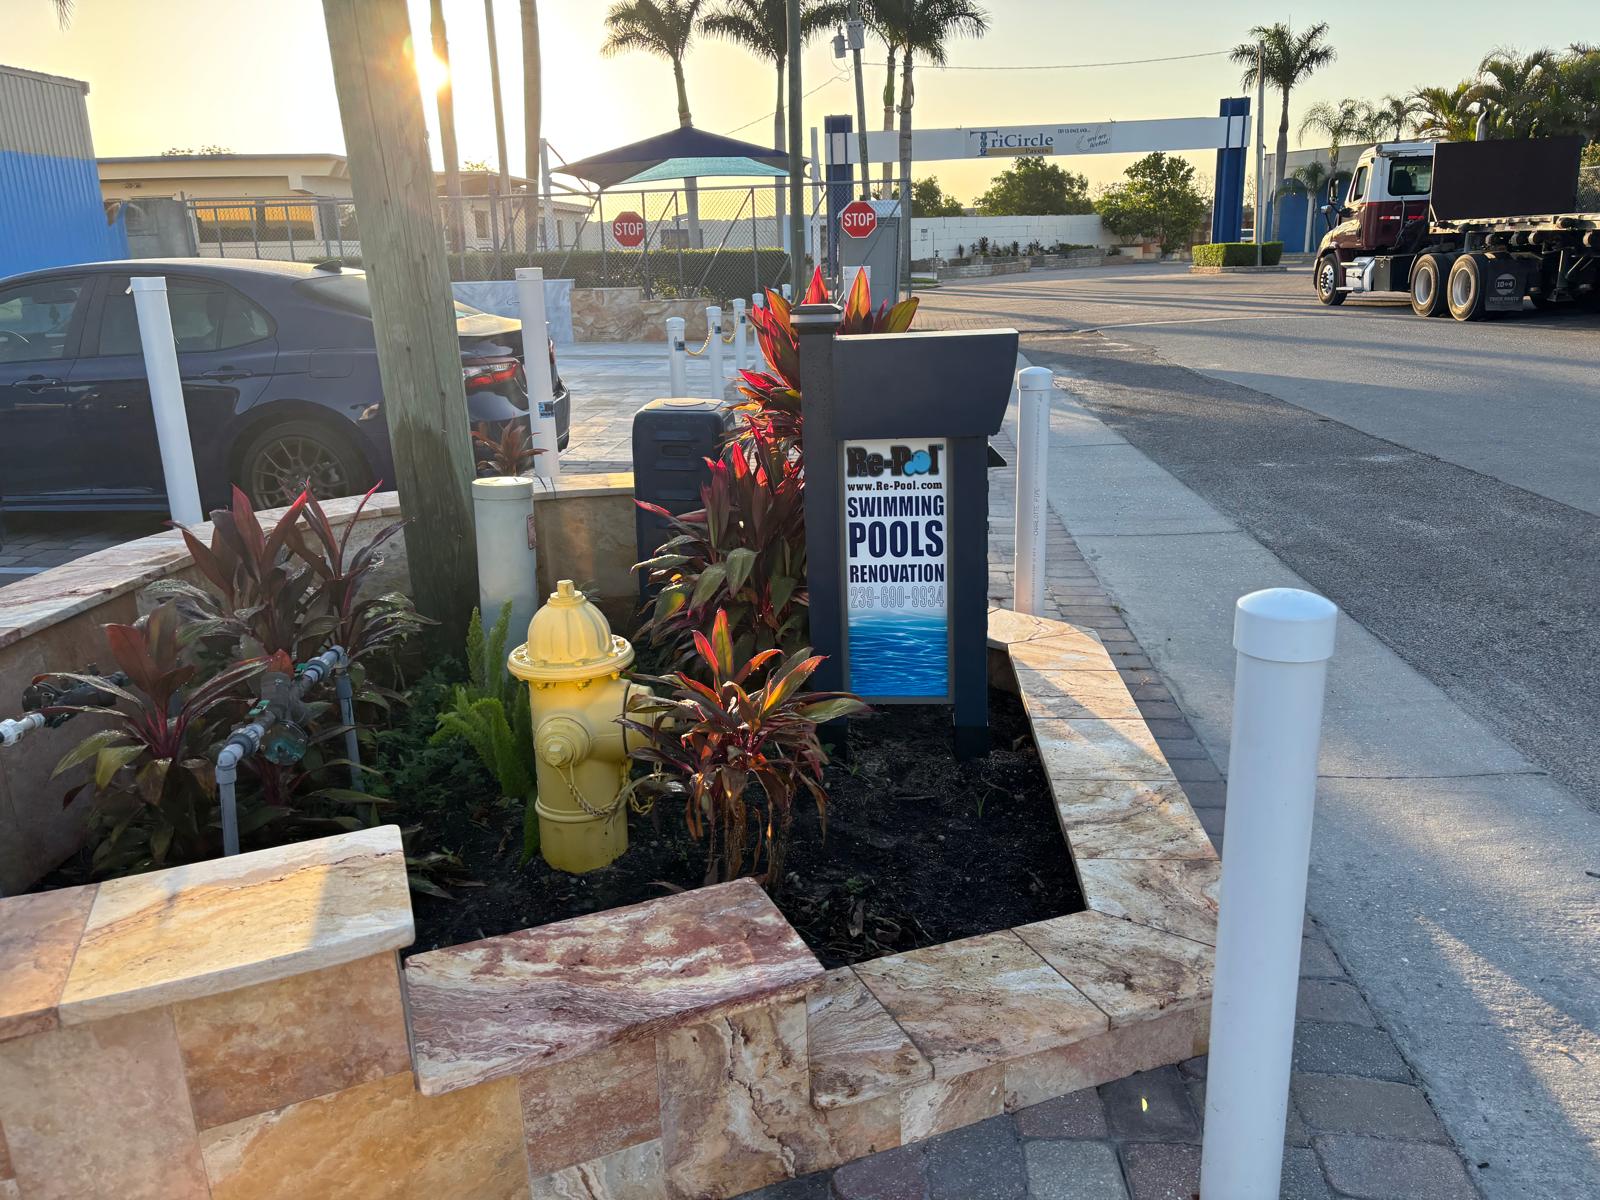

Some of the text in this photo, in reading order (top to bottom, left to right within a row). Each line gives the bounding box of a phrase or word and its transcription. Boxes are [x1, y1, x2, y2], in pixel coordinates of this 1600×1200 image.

[970, 131, 1054, 156] TriCircle
[615, 222, 643, 236] STOP
[844, 212, 874, 227] STOP
[847, 481, 943, 491] www.Re-Pool.com
[847, 494, 945, 518] SWIMMING
[849, 519, 944, 558] POOLS
[849, 563, 945, 583] RENOVATION
[850, 585, 945, 608] 239-690-9934
